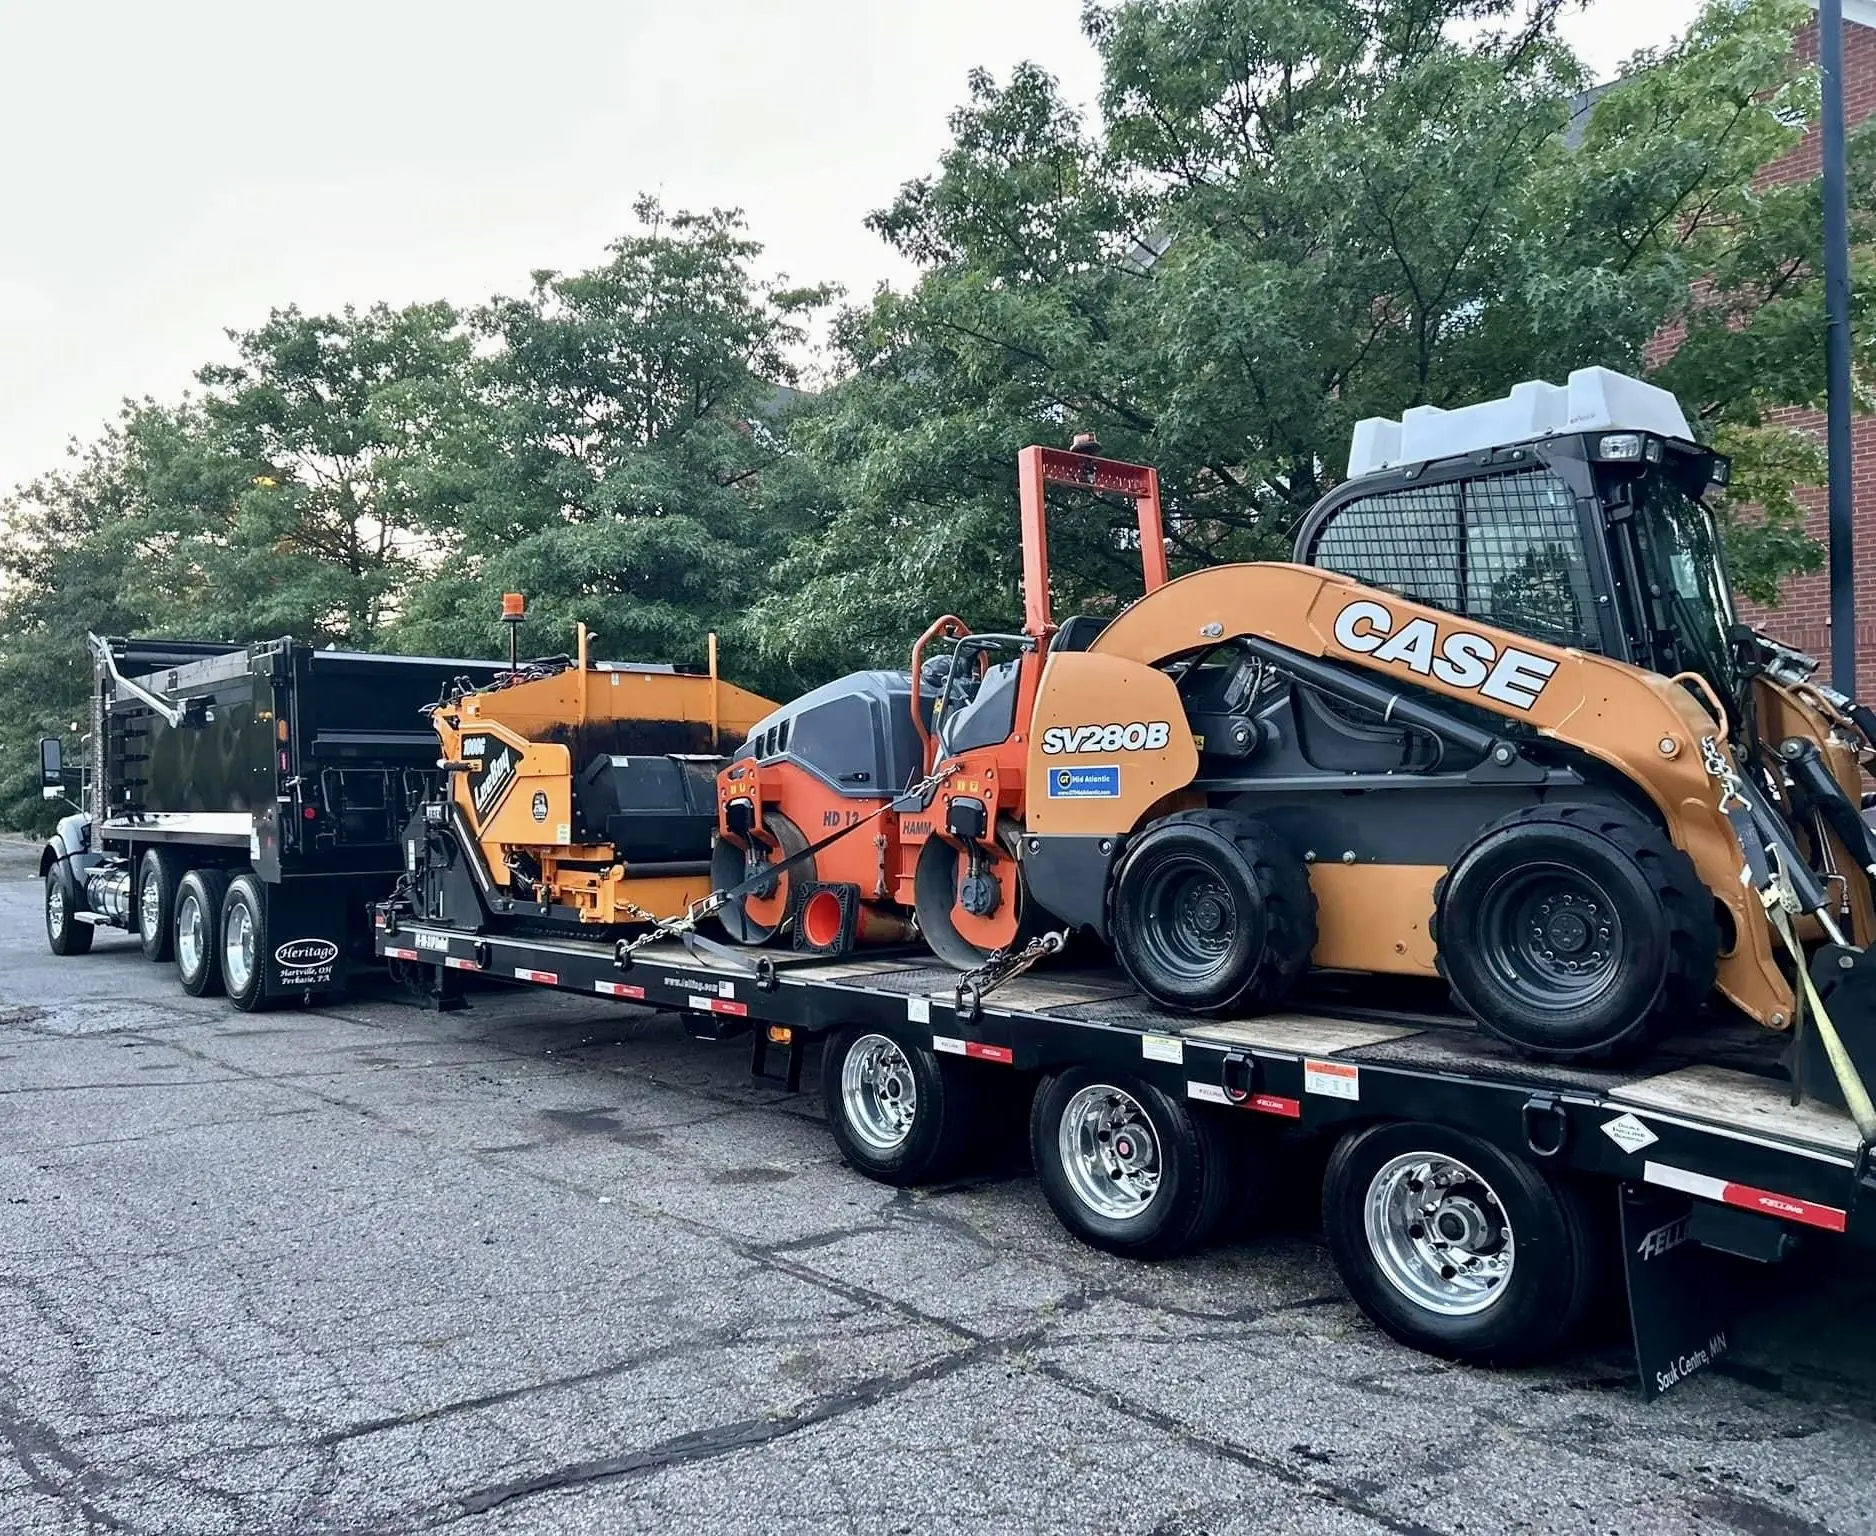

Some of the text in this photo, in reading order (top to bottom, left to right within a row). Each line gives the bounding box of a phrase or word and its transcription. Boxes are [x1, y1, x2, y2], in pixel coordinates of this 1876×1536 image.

[1334, 600, 1560, 711] CASE
[1041, 721, 1171, 754] SV280B
[474, 746, 510, 810] LeeBoy
[1060, 775, 1110, 784] GT Mid Atlantic
[823, 811, 860, 826] HD 12
[280, 946, 334, 959] Heritage
[1758, 1197, 1804, 1214] FELLING
[1656, 1331, 1728, 1392] Sauk Centre, MN
